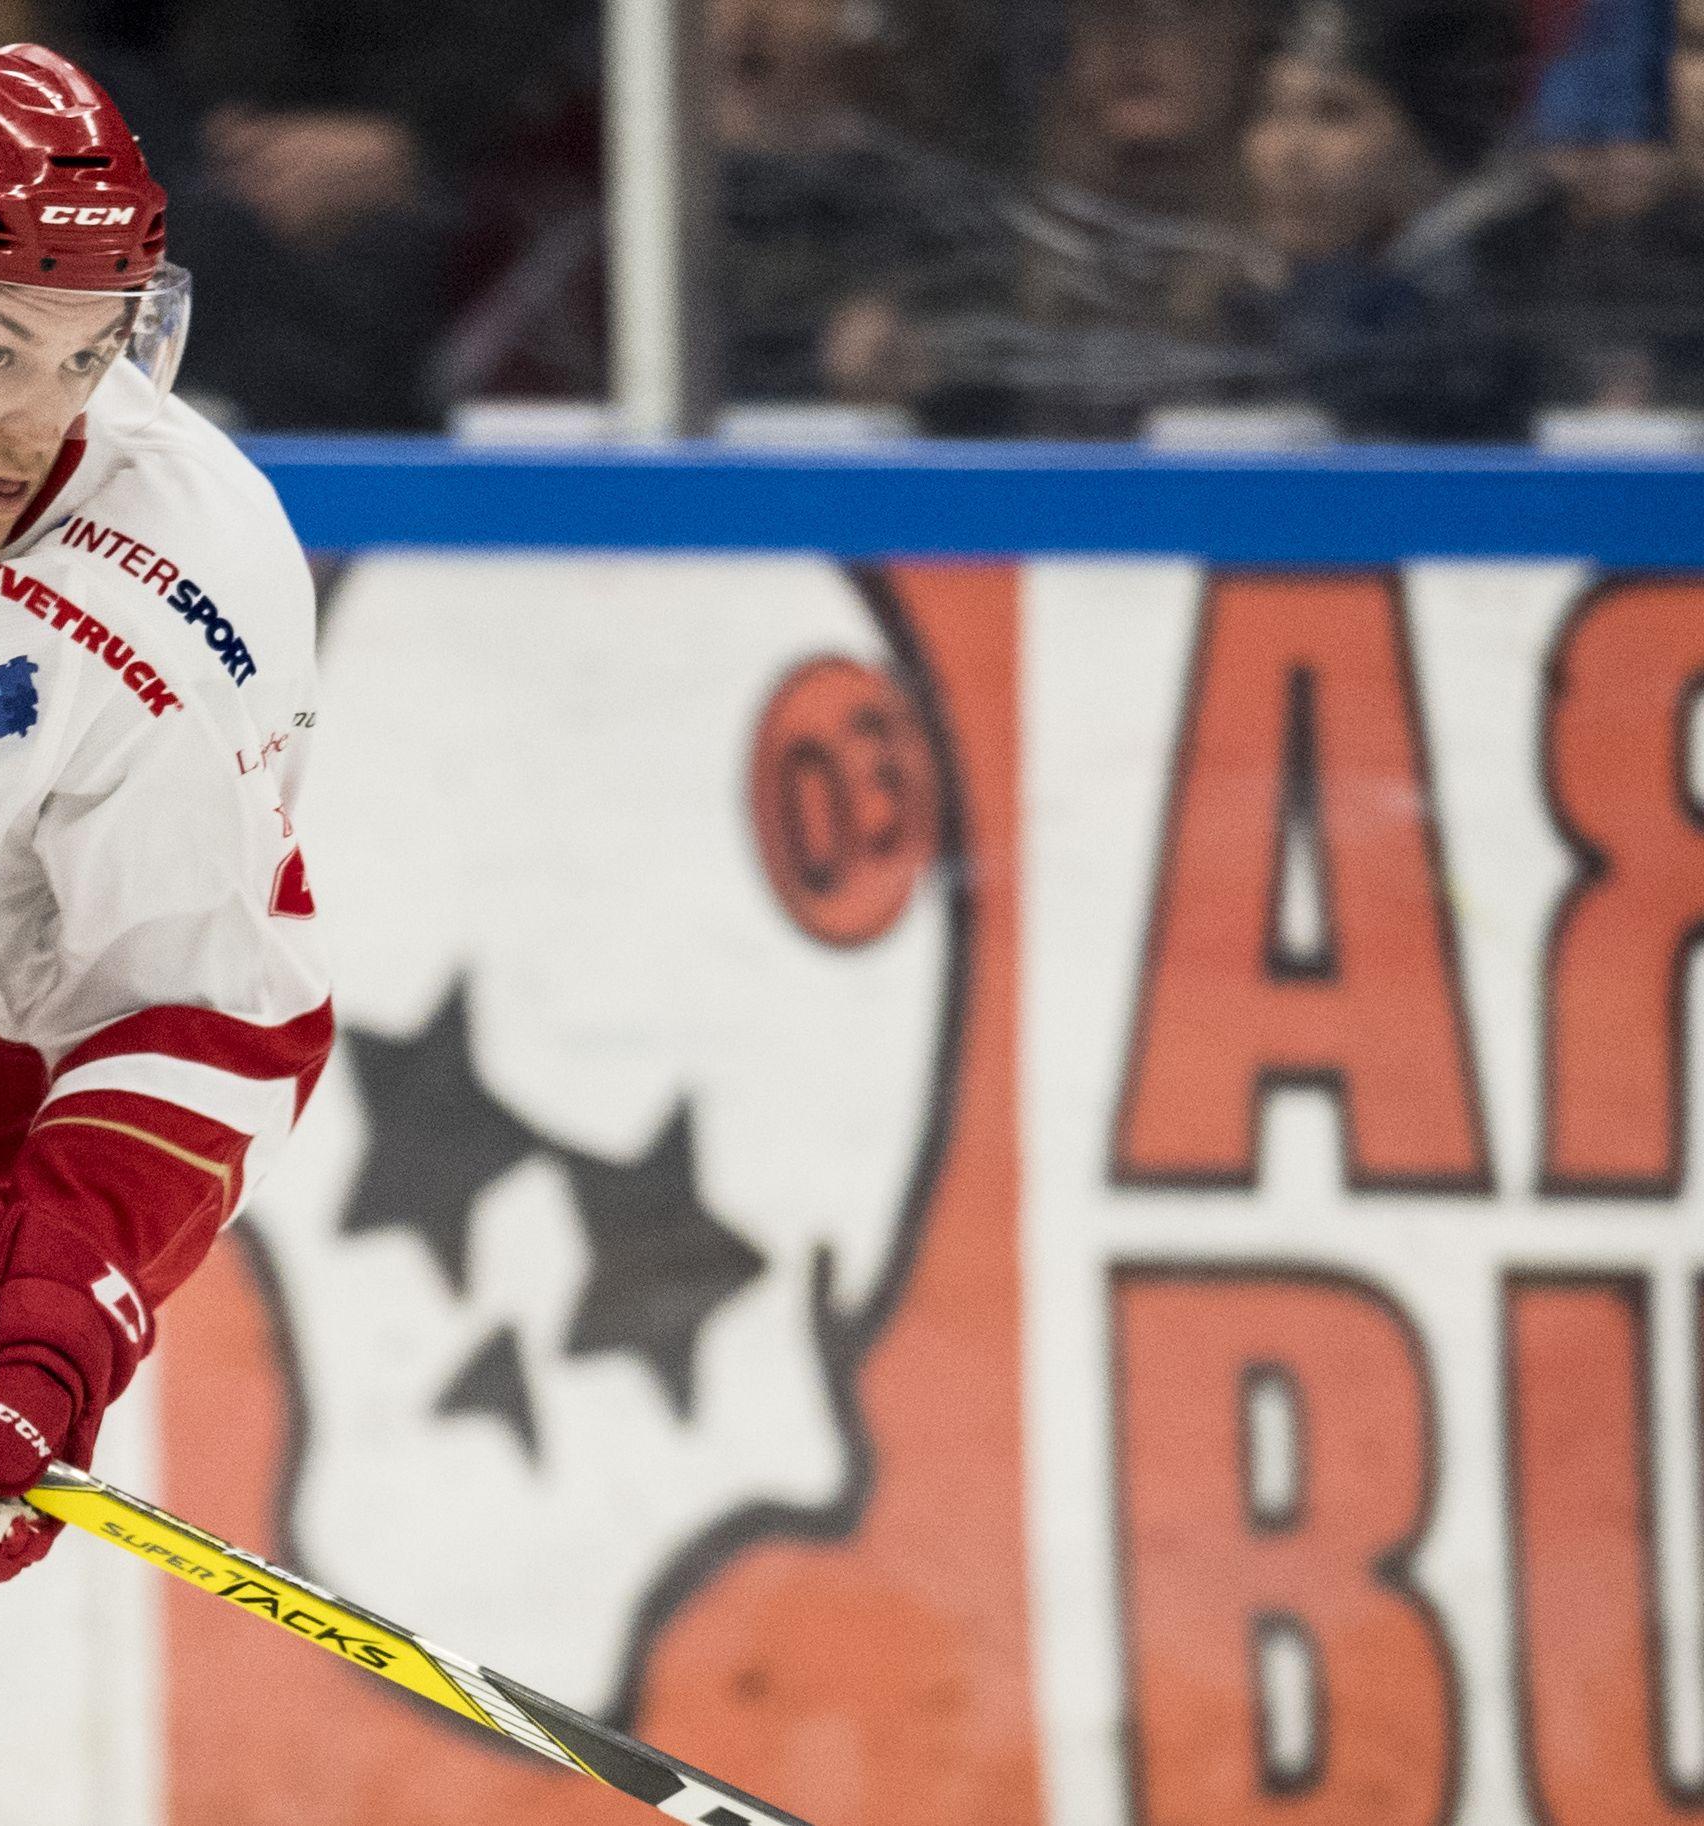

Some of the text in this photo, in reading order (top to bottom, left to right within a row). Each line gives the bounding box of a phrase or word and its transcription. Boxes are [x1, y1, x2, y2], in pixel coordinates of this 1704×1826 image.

[38, 205, 136, 227] CCM
[60, 515, 258, 688] INTERSPORT
[100, 1520, 216, 1581] SUPER
[216, 1578, 400, 1670] TACKS
